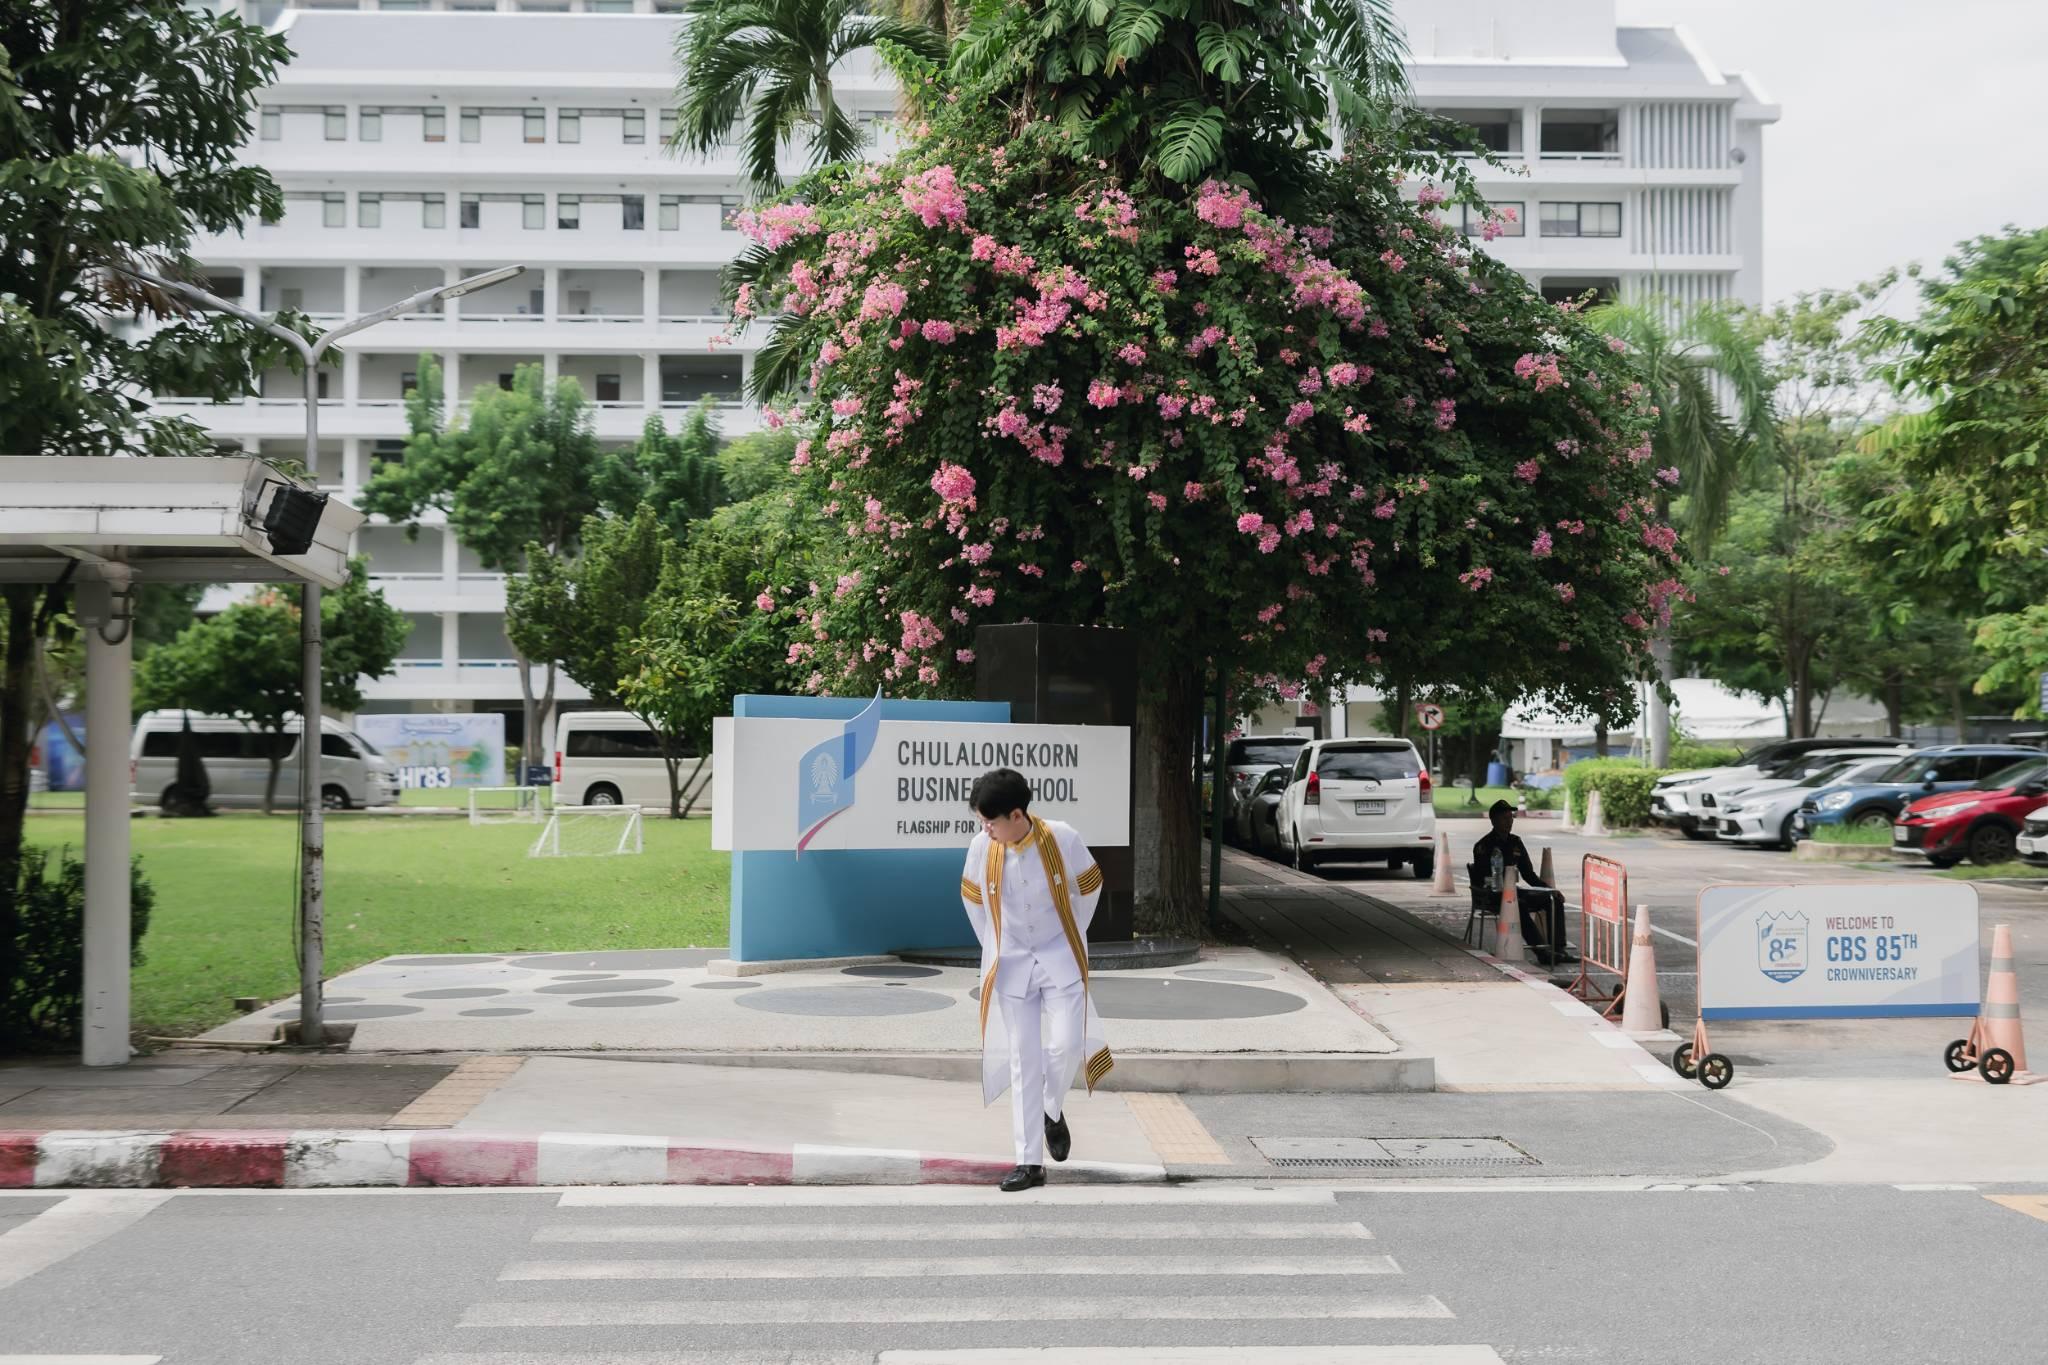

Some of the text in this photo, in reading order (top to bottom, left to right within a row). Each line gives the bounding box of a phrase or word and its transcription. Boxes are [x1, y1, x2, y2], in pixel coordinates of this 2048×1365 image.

[897, 740, 1079, 767] CHULALONGKORN
[897, 777, 1079, 802] BUSINE HOOL
[897, 819, 951, 834] FLAGSHIP
[954, 819, 975, 834] FOR
[1826, 916, 1894, 930] WELCOME TO
[1827, 935, 1867, 962] CBS
[1827, 967, 1918, 982] CROWNIVERSARY
